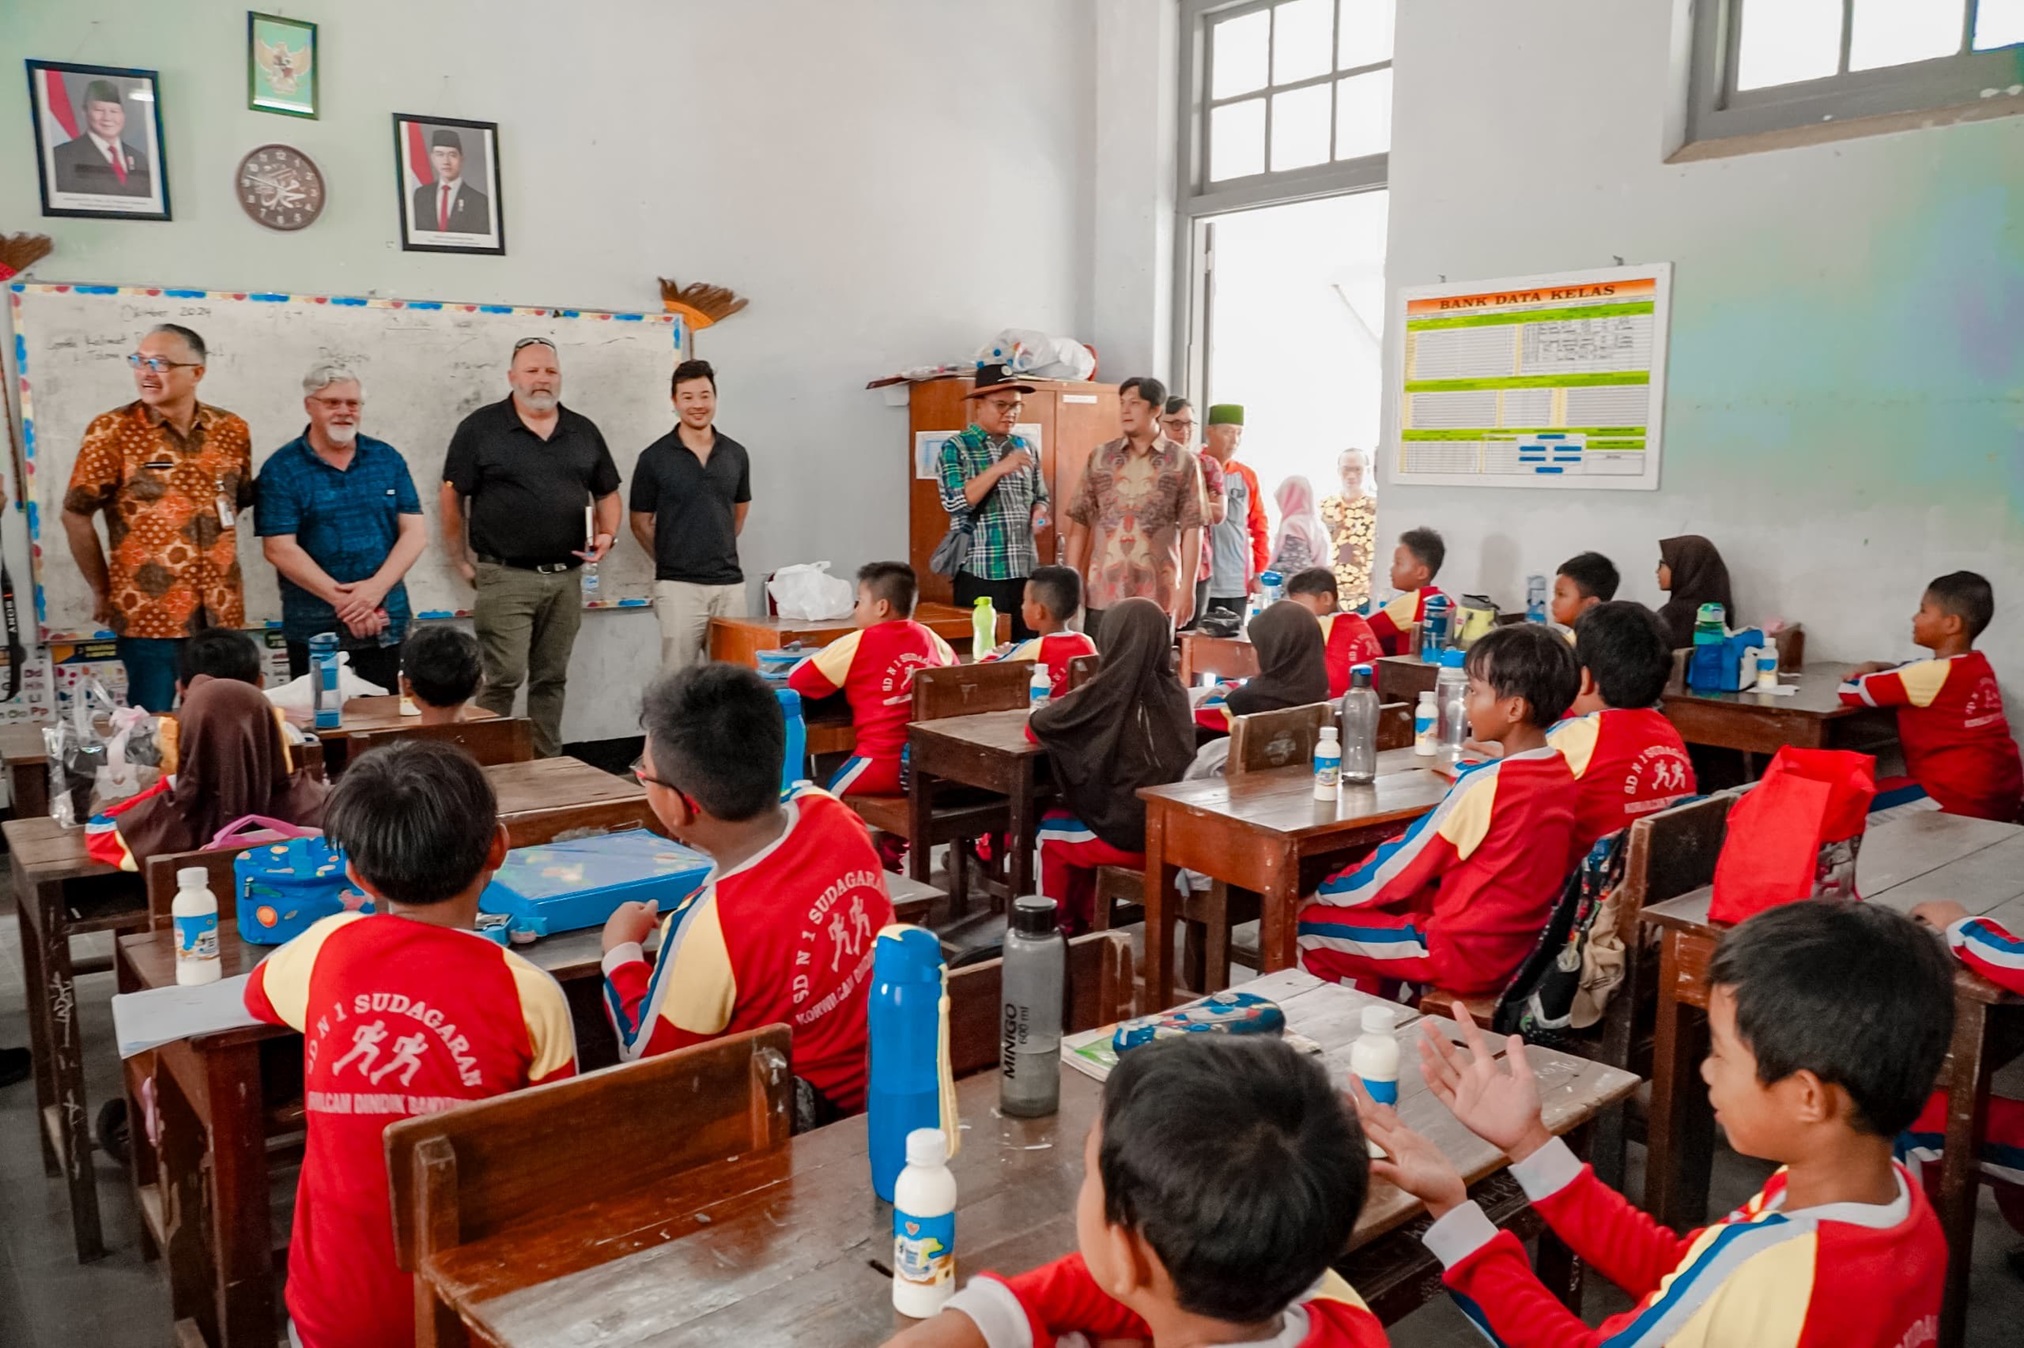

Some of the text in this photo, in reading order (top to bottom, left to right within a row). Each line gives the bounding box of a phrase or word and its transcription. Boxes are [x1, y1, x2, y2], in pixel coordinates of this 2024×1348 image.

[1439, 285, 1616, 310] BANK DATA KELAS
[354, 992, 483, 1087] SUDAGARAN
[1003, 1003, 1017, 1080] MINIGO
